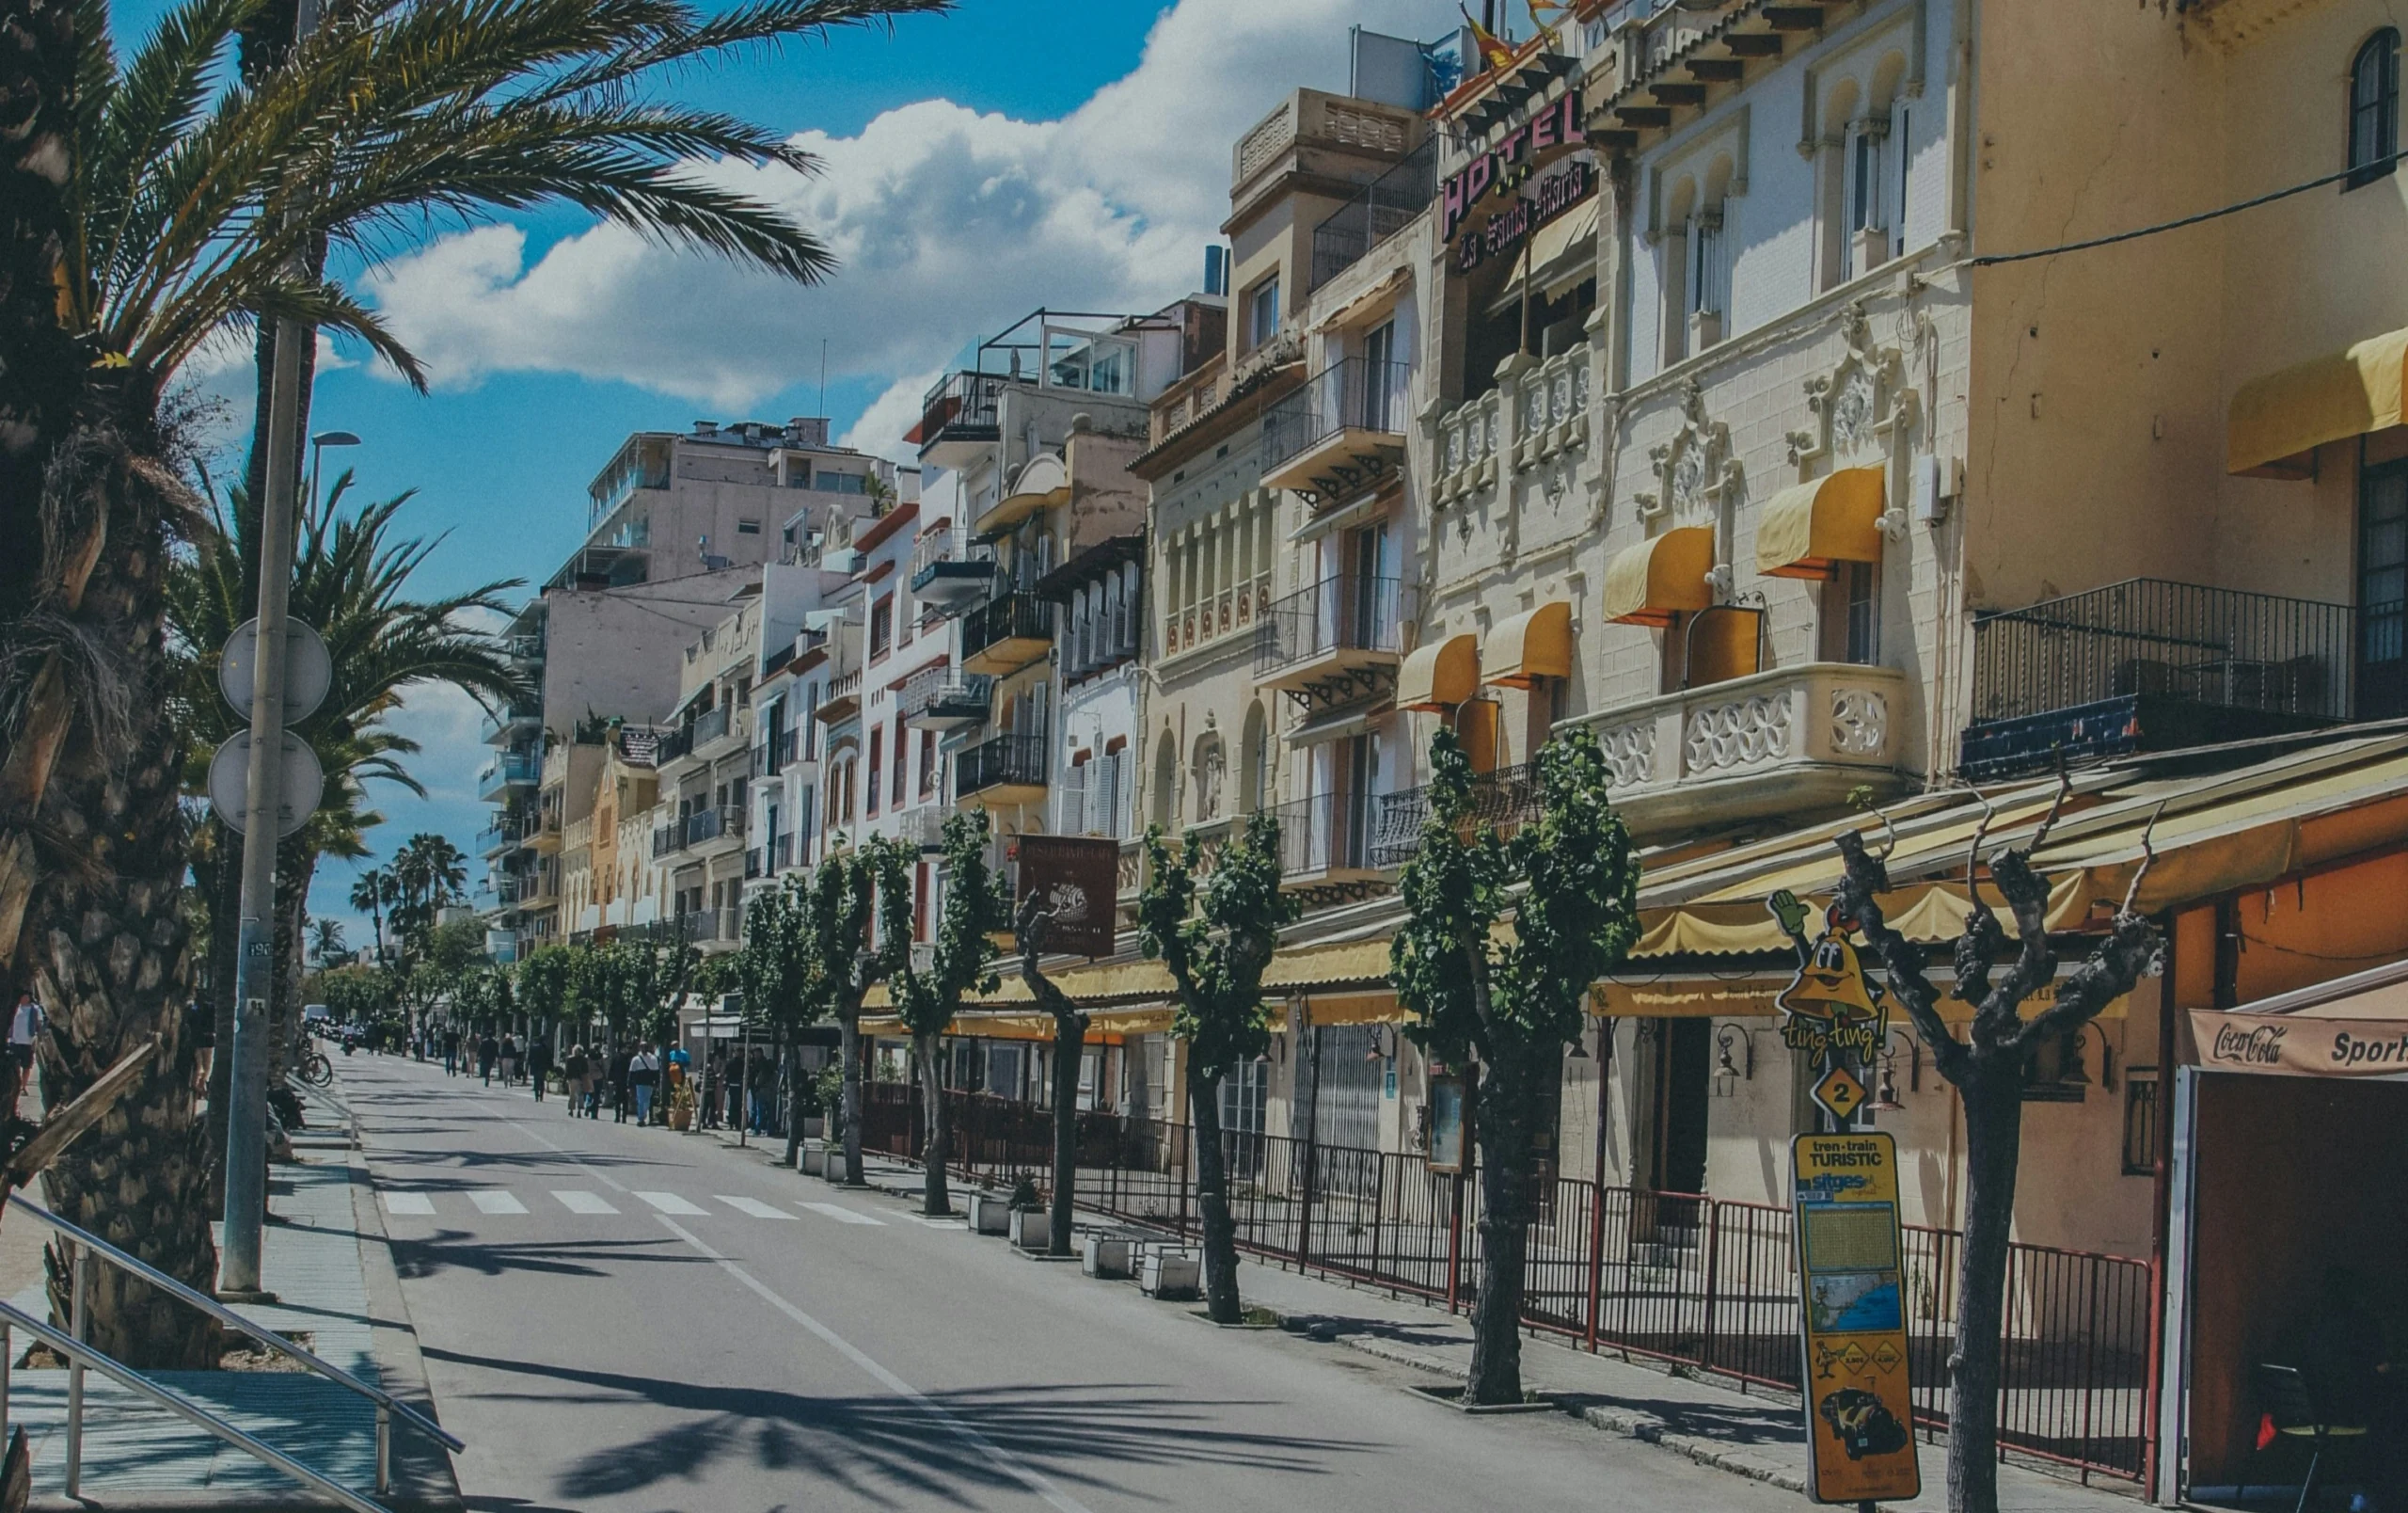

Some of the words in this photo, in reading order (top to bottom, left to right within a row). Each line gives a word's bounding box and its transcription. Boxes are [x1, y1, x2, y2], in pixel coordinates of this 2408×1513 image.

[1443, 92, 1584, 241] HOTEL
[1487, 200, 1528, 257] Santa
[2213, 1023, 2288, 1064] Coca-Cola
[2331, 1031, 2408, 1067] Sport
[1833, 1083, 1850, 1103] 2
[1809, 1152, 1882, 1168] TURISTIC
